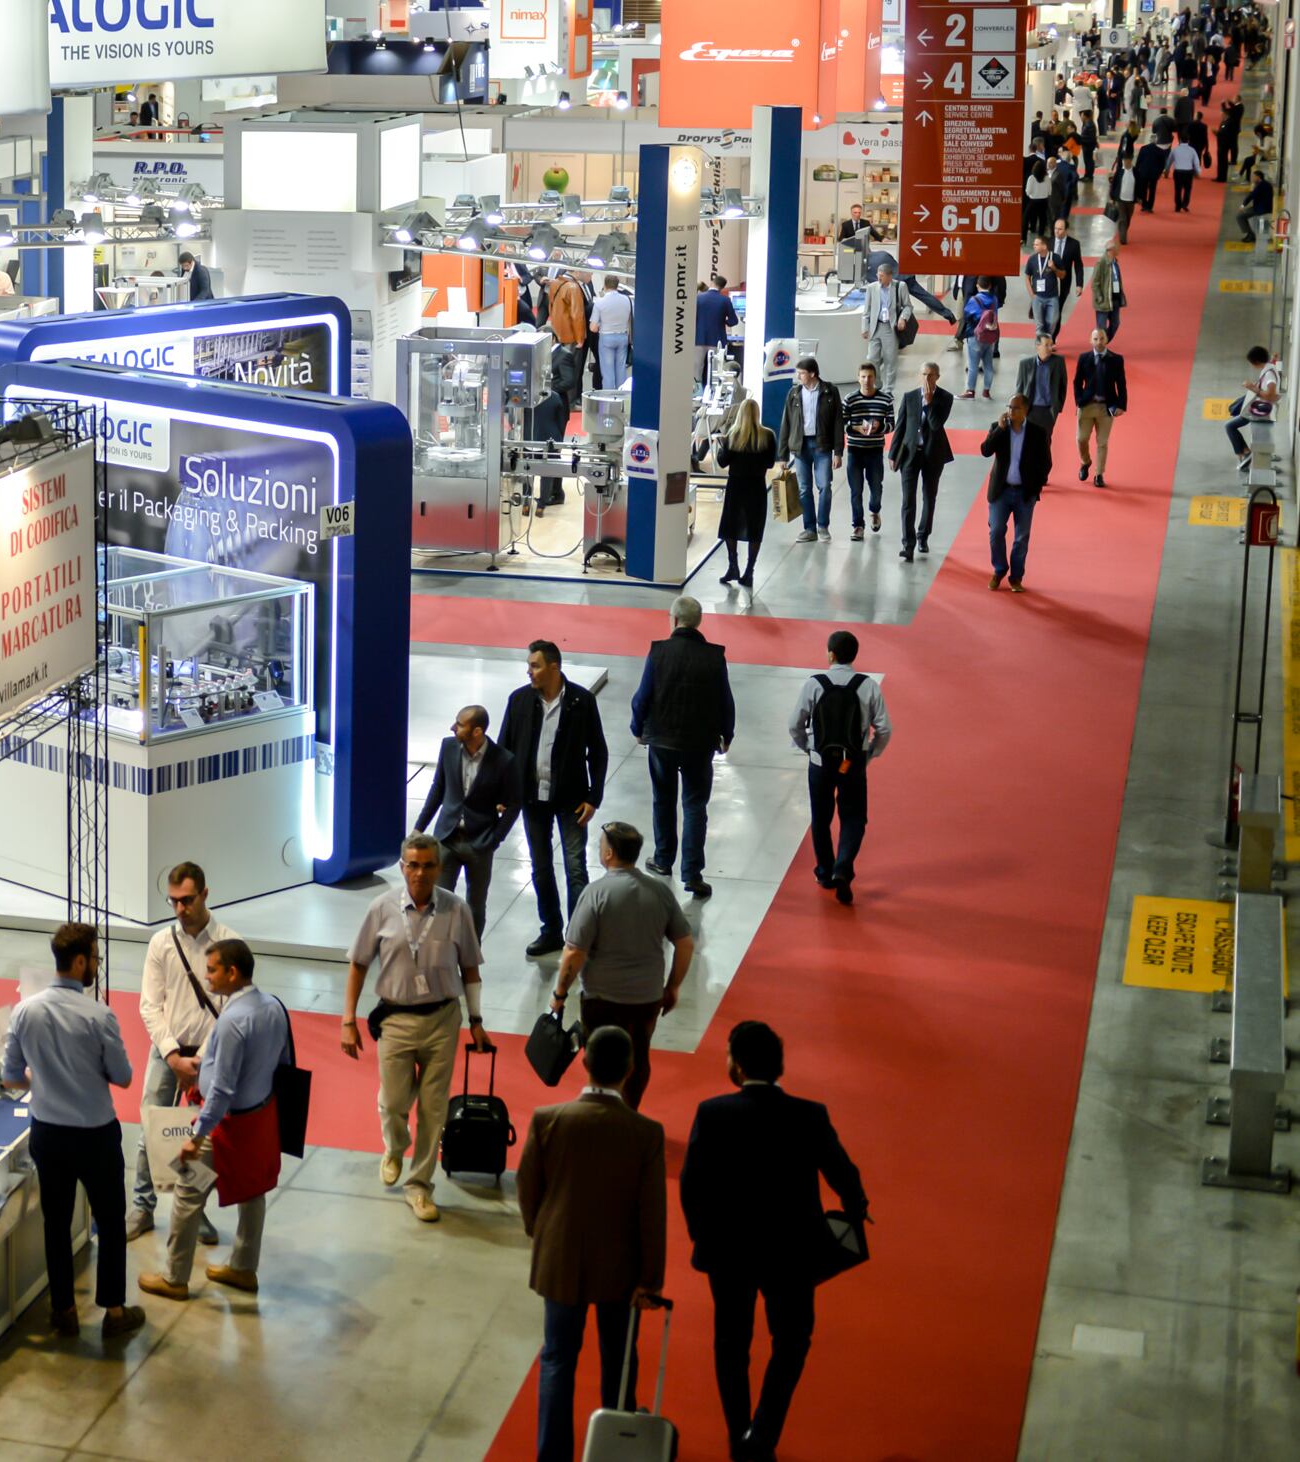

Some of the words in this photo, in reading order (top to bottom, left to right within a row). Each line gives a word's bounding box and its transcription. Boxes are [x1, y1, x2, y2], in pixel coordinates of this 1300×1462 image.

[510, 9, 545, 20] nimax
[945, 13, 966, 47] 2
[61, 45, 90, 61] THE
[95, 43, 143, 60] VISION
[148, 42, 161, 57] IS
[165, 40, 214, 56] YOURS
[679, 41, 795, 62] Espera
[943, 62, 965, 95] 4
[677, 134, 721, 144] Drorys
[858, 138, 879, 146] Vera
[133, 161, 187, 175] R.P.O.
[942, 205, 1000, 232] 6-10
[674, 244, 688, 355] www.pmr.it
[235, 352, 313, 387] Novità
[129, 449, 152, 461] YOURS
[22, 473, 66, 515] SISTEMI
[184, 456, 317, 515] Soluzioni
[119, 490, 128, 512] il
[133, 492, 221, 535] Packaging
[226, 509, 239, 532] &
[246, 511, 318, 554] Packing
[326, 506, 349, 524] V06
[11, 531, 23, 557] DI
[27, 504, 78, 550] CODIFICA
[1, 555, 82, 620] PORTATILI
[1, 593, 82, 658] MARCATURA
[1146, 915, 1168, 936] KEEP
[1174, 912, 1197, 945] ESCAPE
[1141, 938, 1166, 966] CLEAR
[1171, 946, 1195, 974] ROUTE
